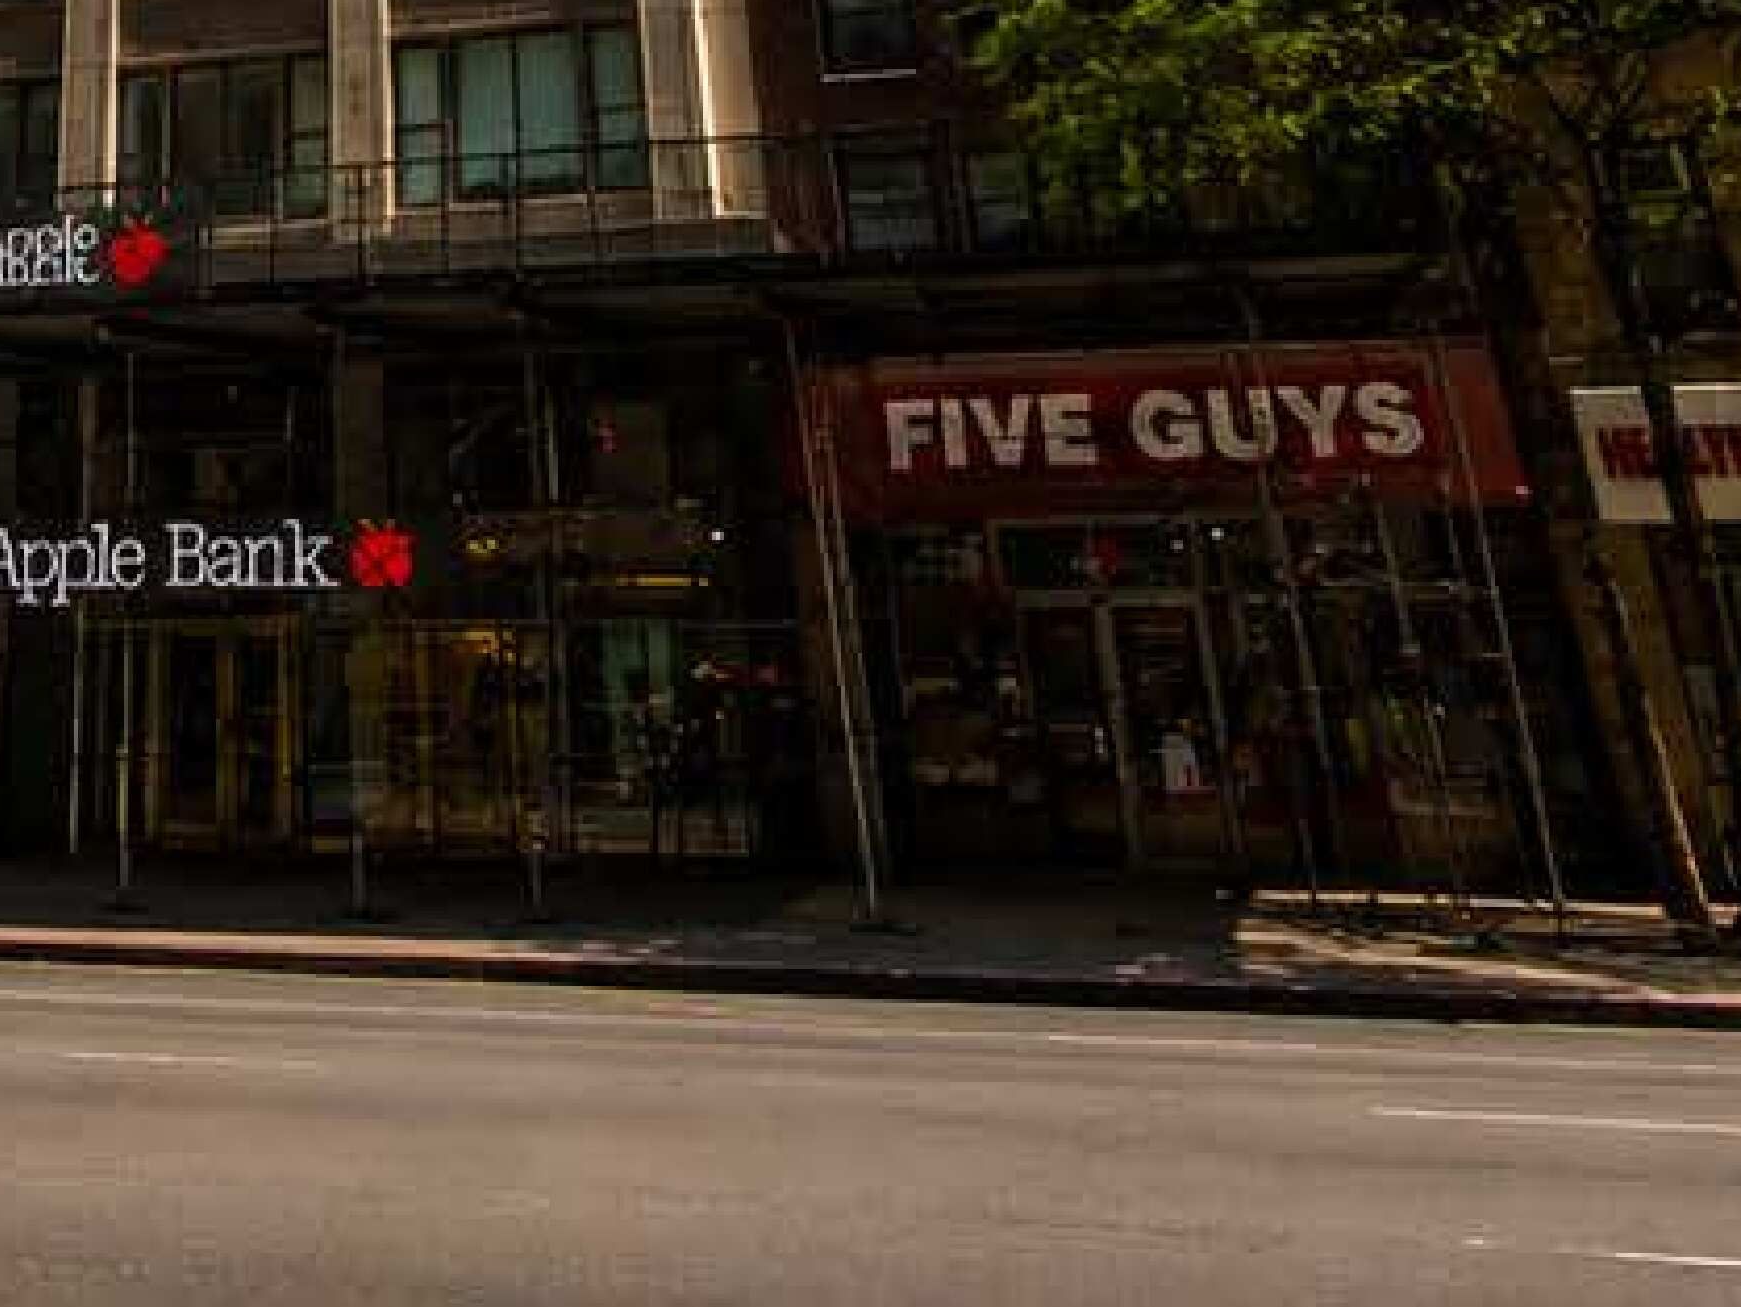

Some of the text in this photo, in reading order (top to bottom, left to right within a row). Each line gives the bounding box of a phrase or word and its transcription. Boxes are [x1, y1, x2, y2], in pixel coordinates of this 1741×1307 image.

[883, 381, 1423, 474] FIVE GUYS
[164, 518, 343, 588] Bank
